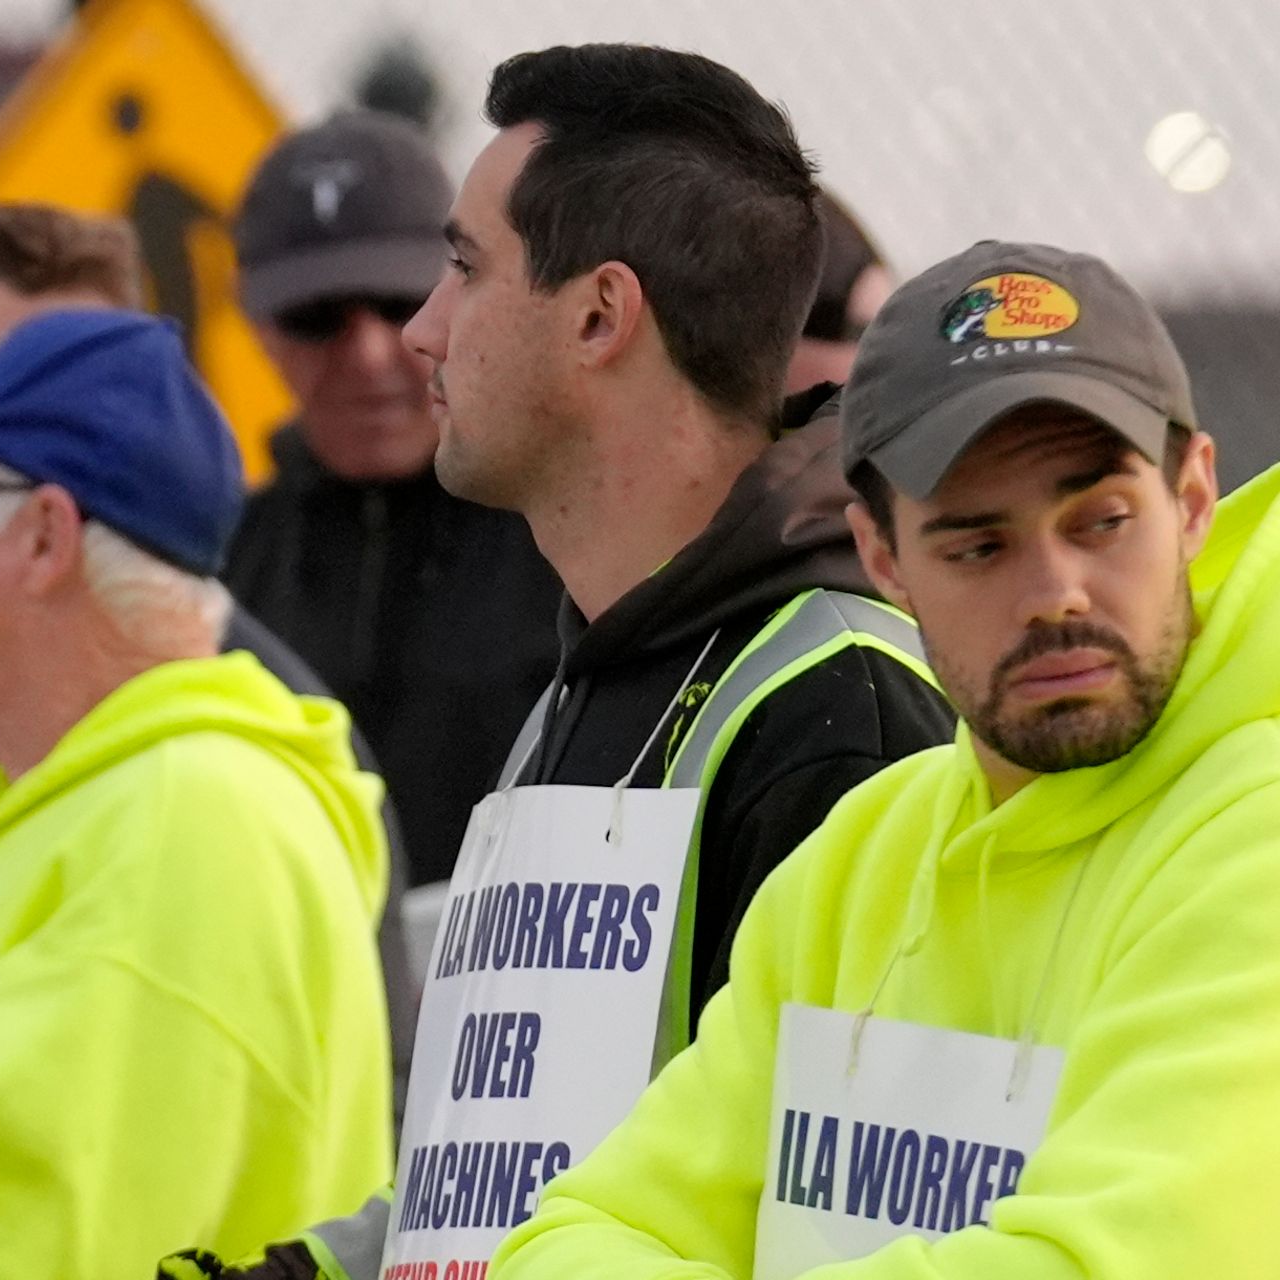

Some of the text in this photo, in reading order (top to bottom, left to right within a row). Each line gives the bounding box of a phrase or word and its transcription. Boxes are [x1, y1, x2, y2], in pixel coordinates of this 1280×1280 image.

[998, 276, 1052, 294] Bass
[1002, 292, 1041, 309] Pro
[1001, 309, 1070, 329] Shops
[435, 882, 660, 980] ILA WORKERS
[451, 1012, 541, 1101] OVER
[776, 1109, 839, 1211] ILA
